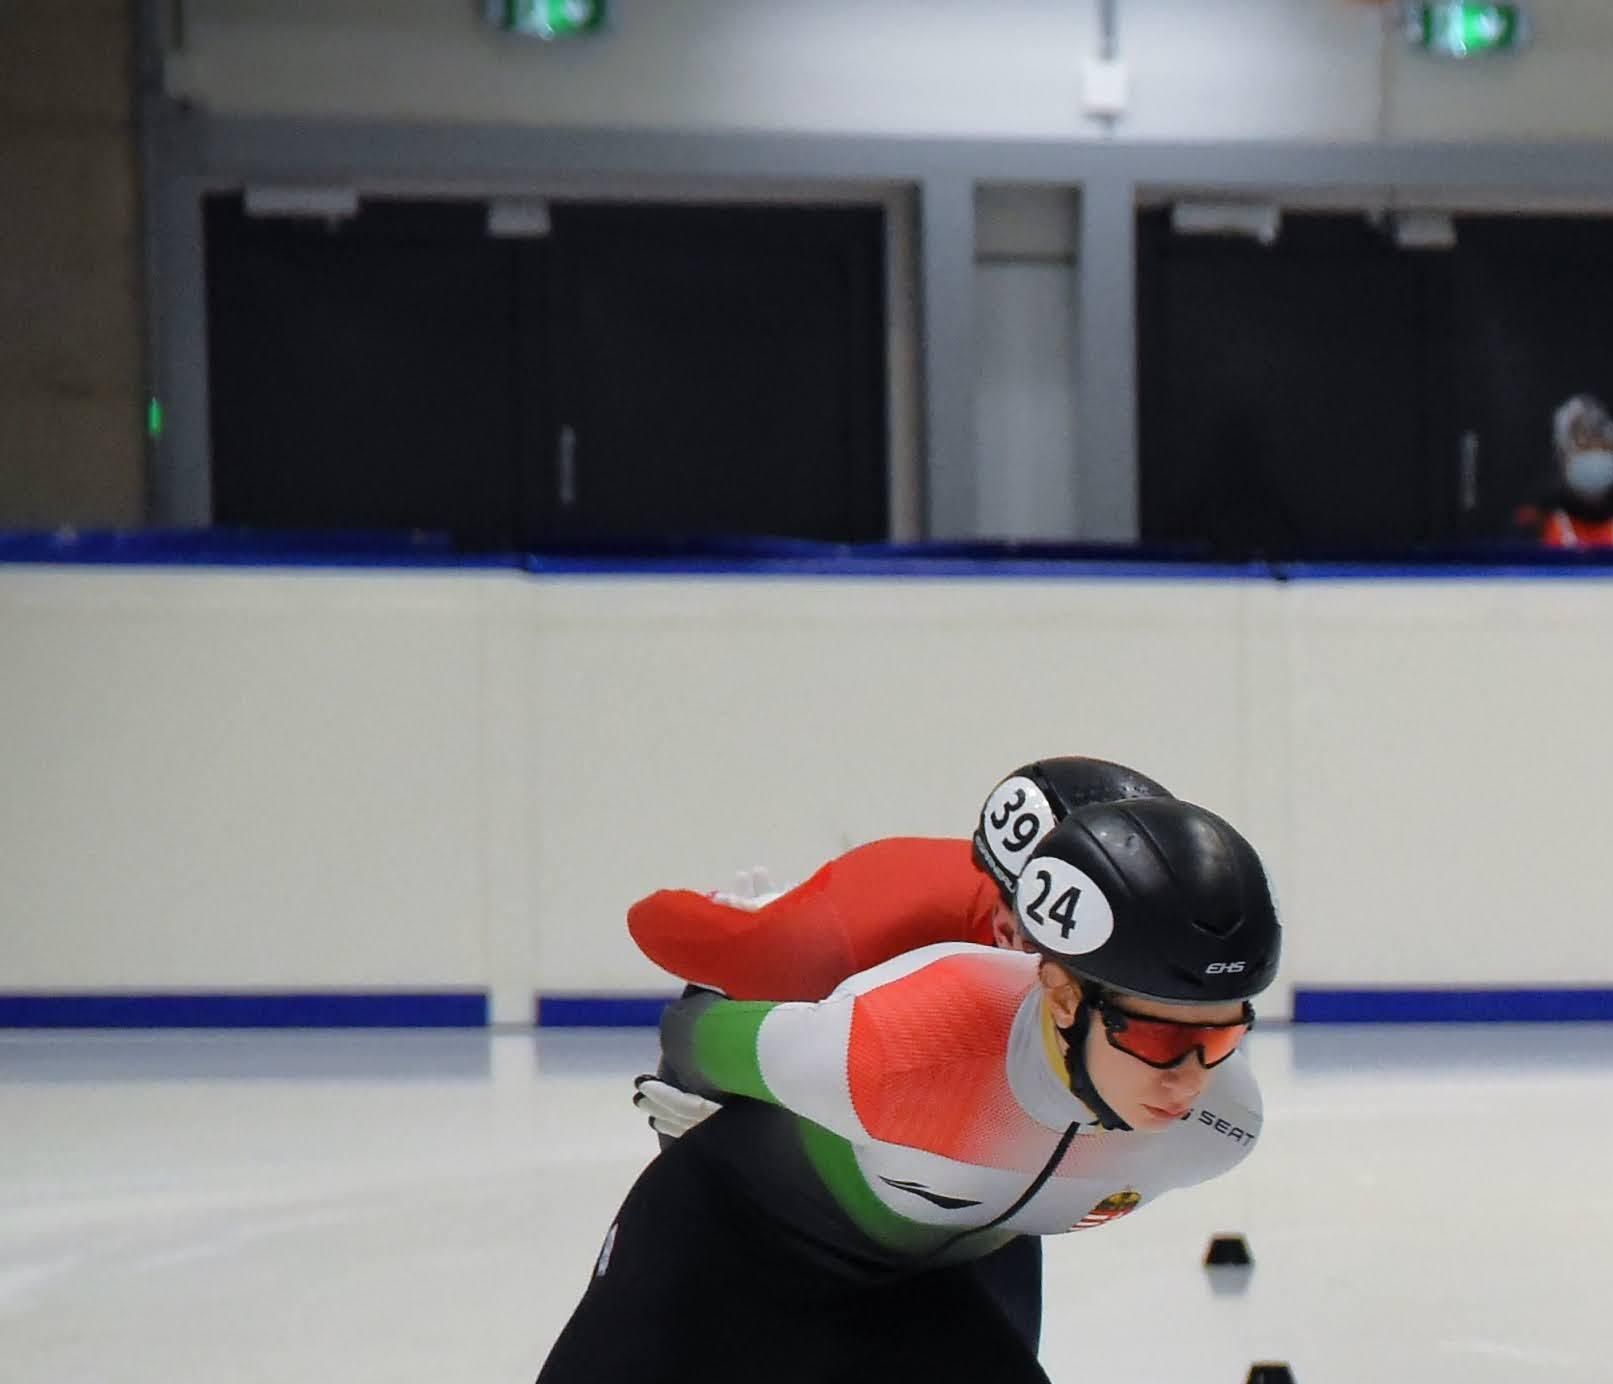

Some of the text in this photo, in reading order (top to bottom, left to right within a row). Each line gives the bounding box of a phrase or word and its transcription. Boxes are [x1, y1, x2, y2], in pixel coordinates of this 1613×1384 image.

[991, 789, 1040, 853] 39
[1025, 870, 1082, 939] 24
[1206, 961, 1246, 974] EHS
[1198, 1110, 1254, 1146] SEAT
